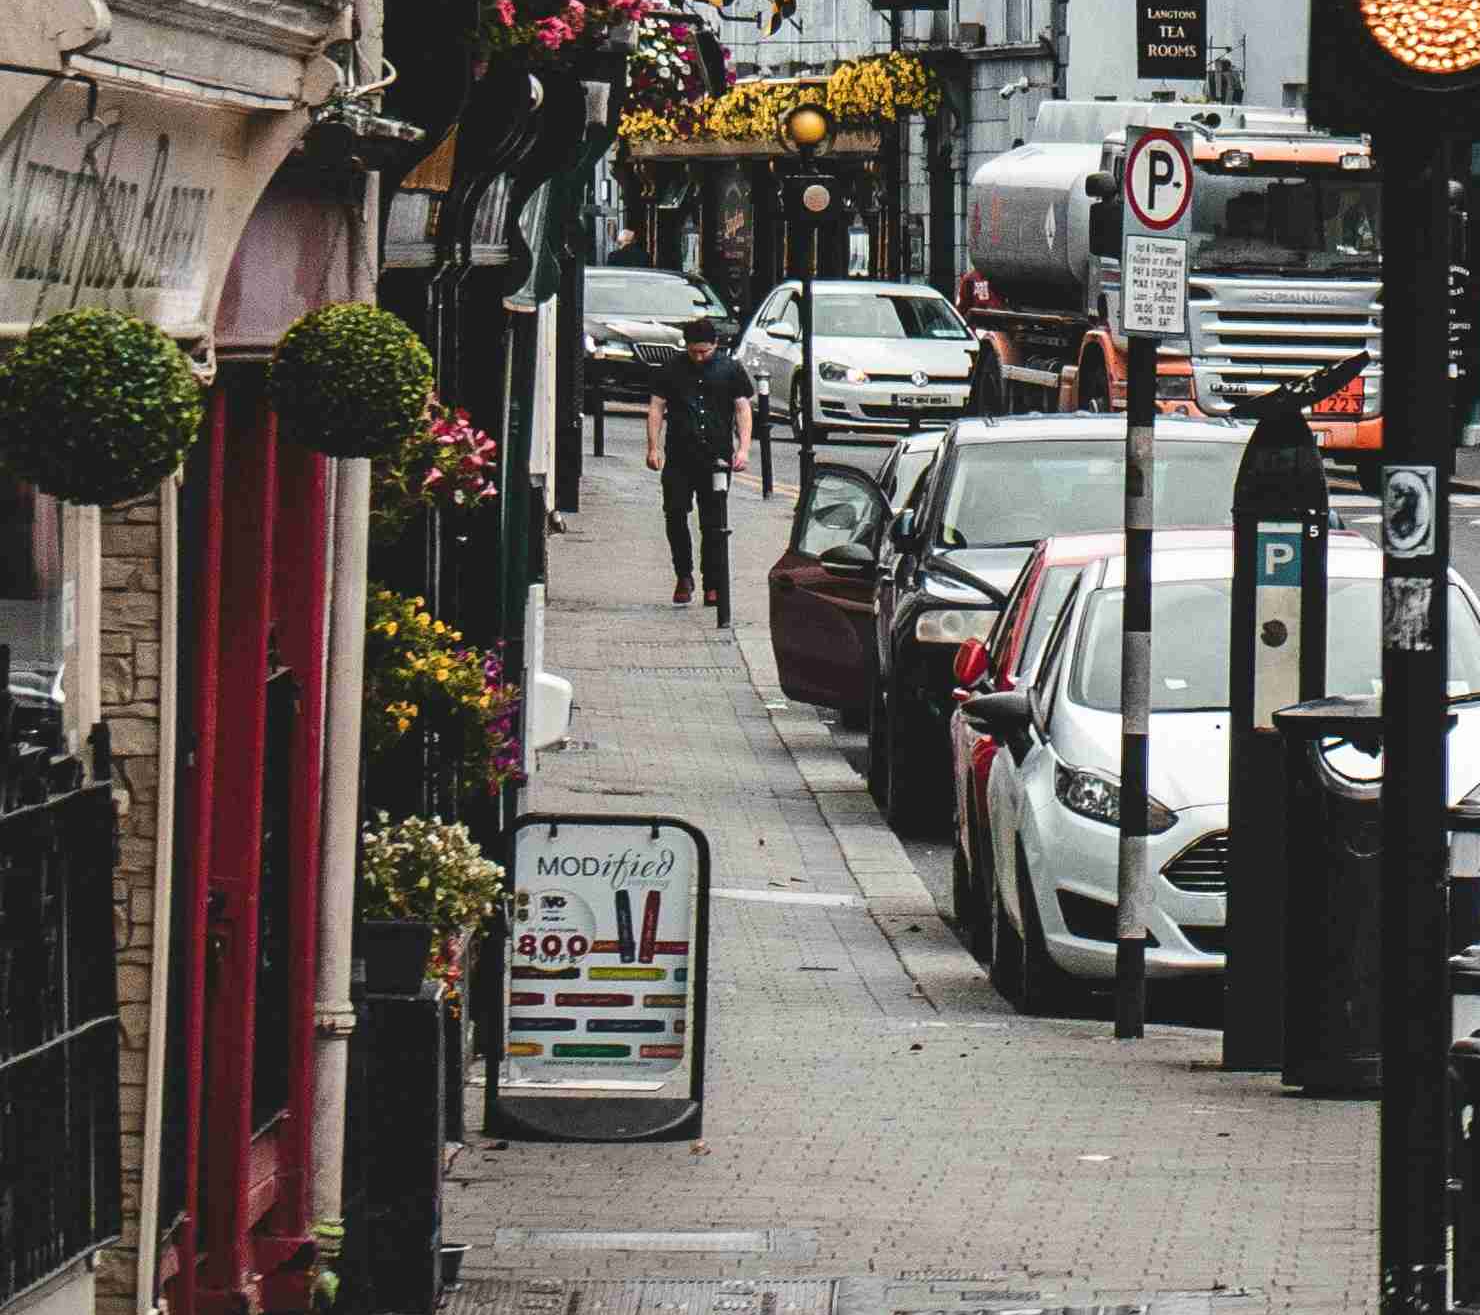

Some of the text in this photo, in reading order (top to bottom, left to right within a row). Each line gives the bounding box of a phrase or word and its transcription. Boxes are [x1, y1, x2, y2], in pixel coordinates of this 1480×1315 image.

[1159, 25, 1185, 39] TEA
[1148, 43, 1197, 58] ROOMS
[1148, 150, 1175, 210] P
[1309, 525, 1320, 538] 5
[1264, 542, 1295, 576] P
[537, 848, 676, 891] MODified
[517, 934, 589, 958] 800
